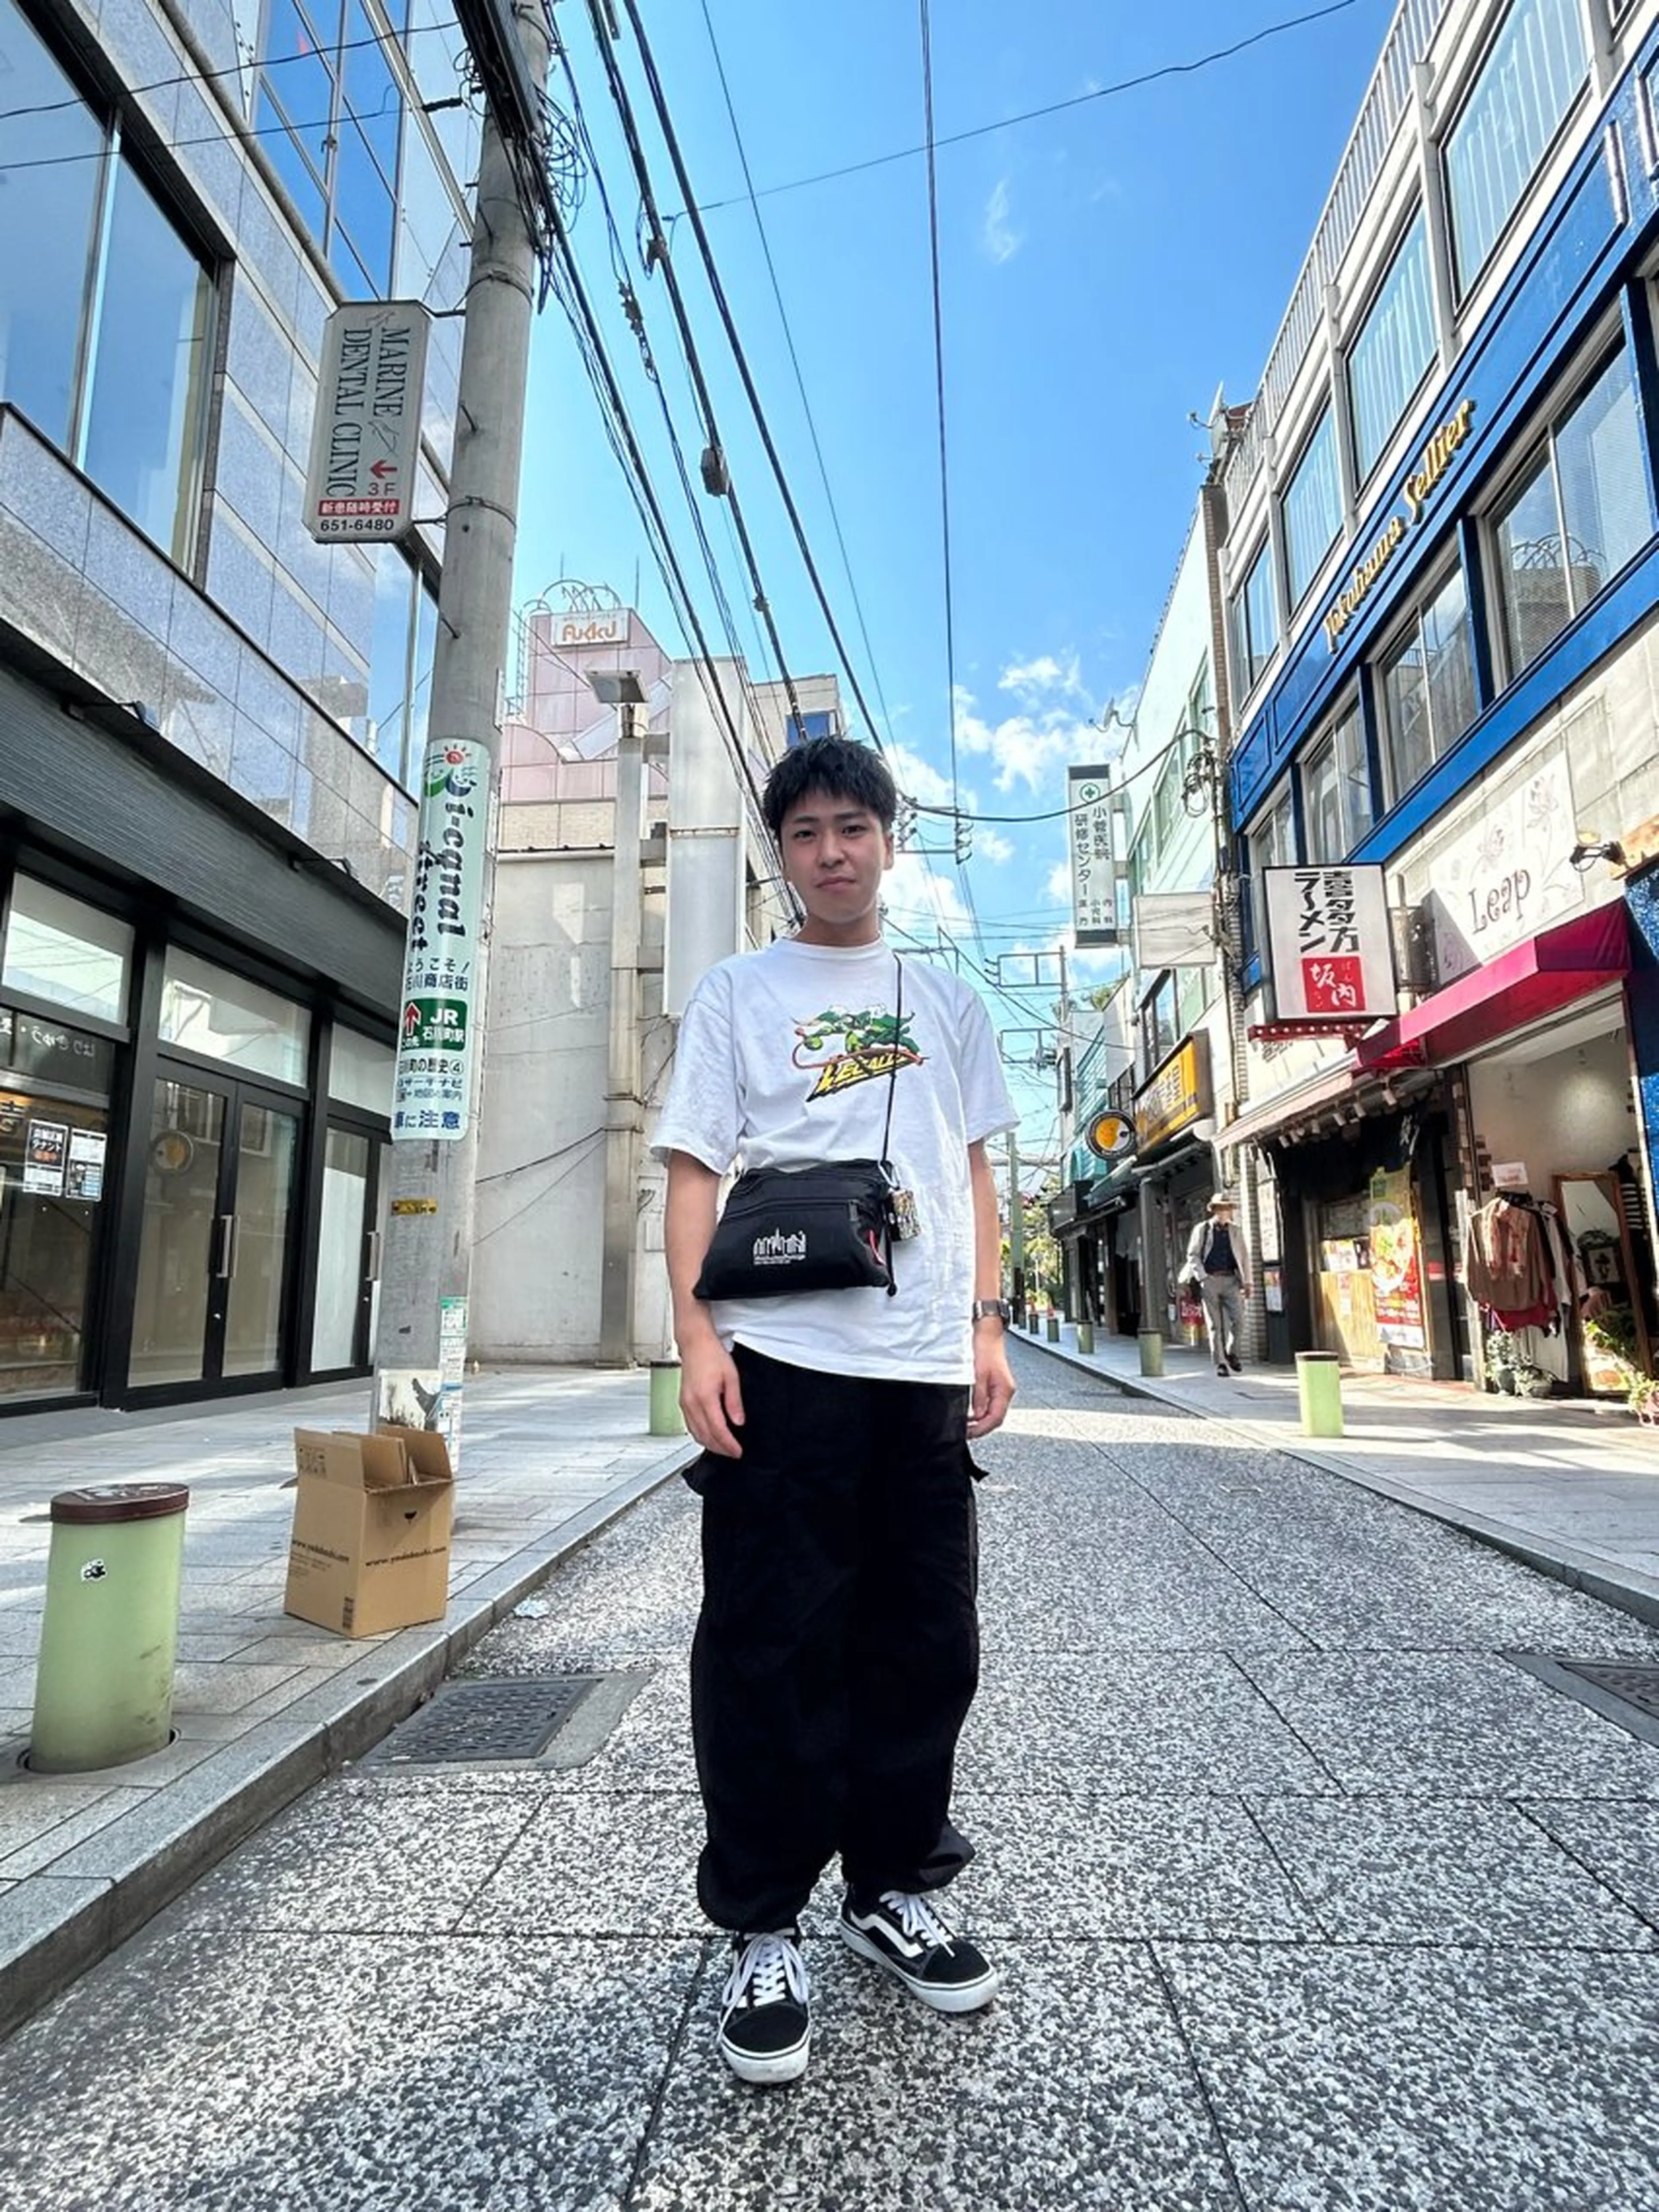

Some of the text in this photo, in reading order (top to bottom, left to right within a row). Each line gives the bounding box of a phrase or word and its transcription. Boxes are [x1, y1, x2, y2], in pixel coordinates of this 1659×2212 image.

[326, 328, 372, 496] DENTAL CLINIC
[373, 327, 411, 417] MARINE
[1403, 398, 1477, 525] Sellier
[320, 519, 395, 531] 651-6480
[1294, 871, 1326, 953] ラーメン
[1323, 870, 1360, 953] 喜多方
[1468, 868, 1532, 935] Leap
[430, 1007, 459, 1026] JR
[1309, 963, 1357, 1007] 坂内
